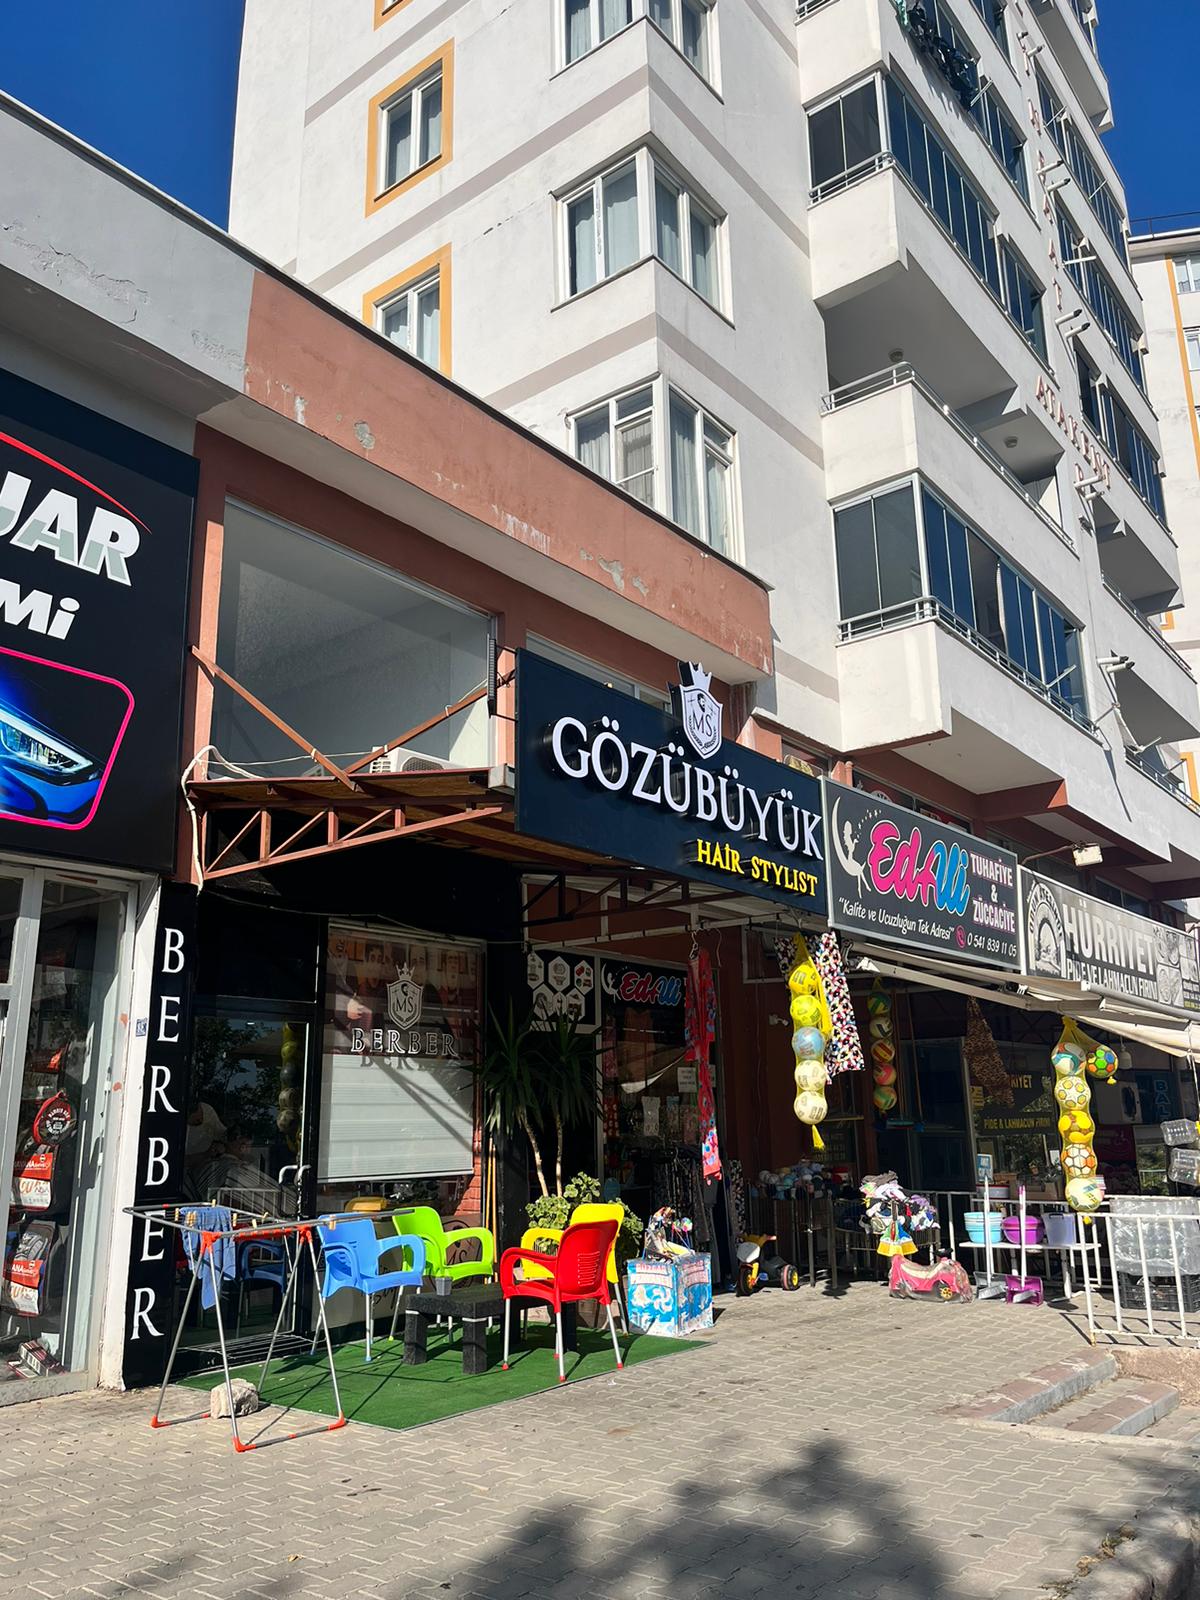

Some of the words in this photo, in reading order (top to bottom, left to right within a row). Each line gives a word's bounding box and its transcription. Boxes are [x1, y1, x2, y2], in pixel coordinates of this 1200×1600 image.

[692, 712, 714, 738] MS
[552, 715, 824, 861] GÖZÜBÜYÜK
[751, 855, 818, 897] STYLIST
[970, 851, 1013, 887] TUHAFİYE
[990, 884, 999, 903] &
[867, 910, 877, 922] ve
[878, 911, 916, 935] Ucuzluğun
[918, 919, 930, 936] Tek
[972, 897, 1016, 935] ZÜCCACİYE
[967, 933, 973, 944] 0
[973, 934, 985, 945] 541
[986, 938, 1000, 953] 839
[1001, 942, 1008, 955] 11
[1008, 944, 1017, 958] 05
[1062, 899, 1155, 976] HÜRRİYET
[1098, 966, 1139, 996] LAHMACUN
[396, 995, 414, 1014] MS
[350, 1027, 460, 1058] BERBER
[130, 926, 185, 1341] BERBER
